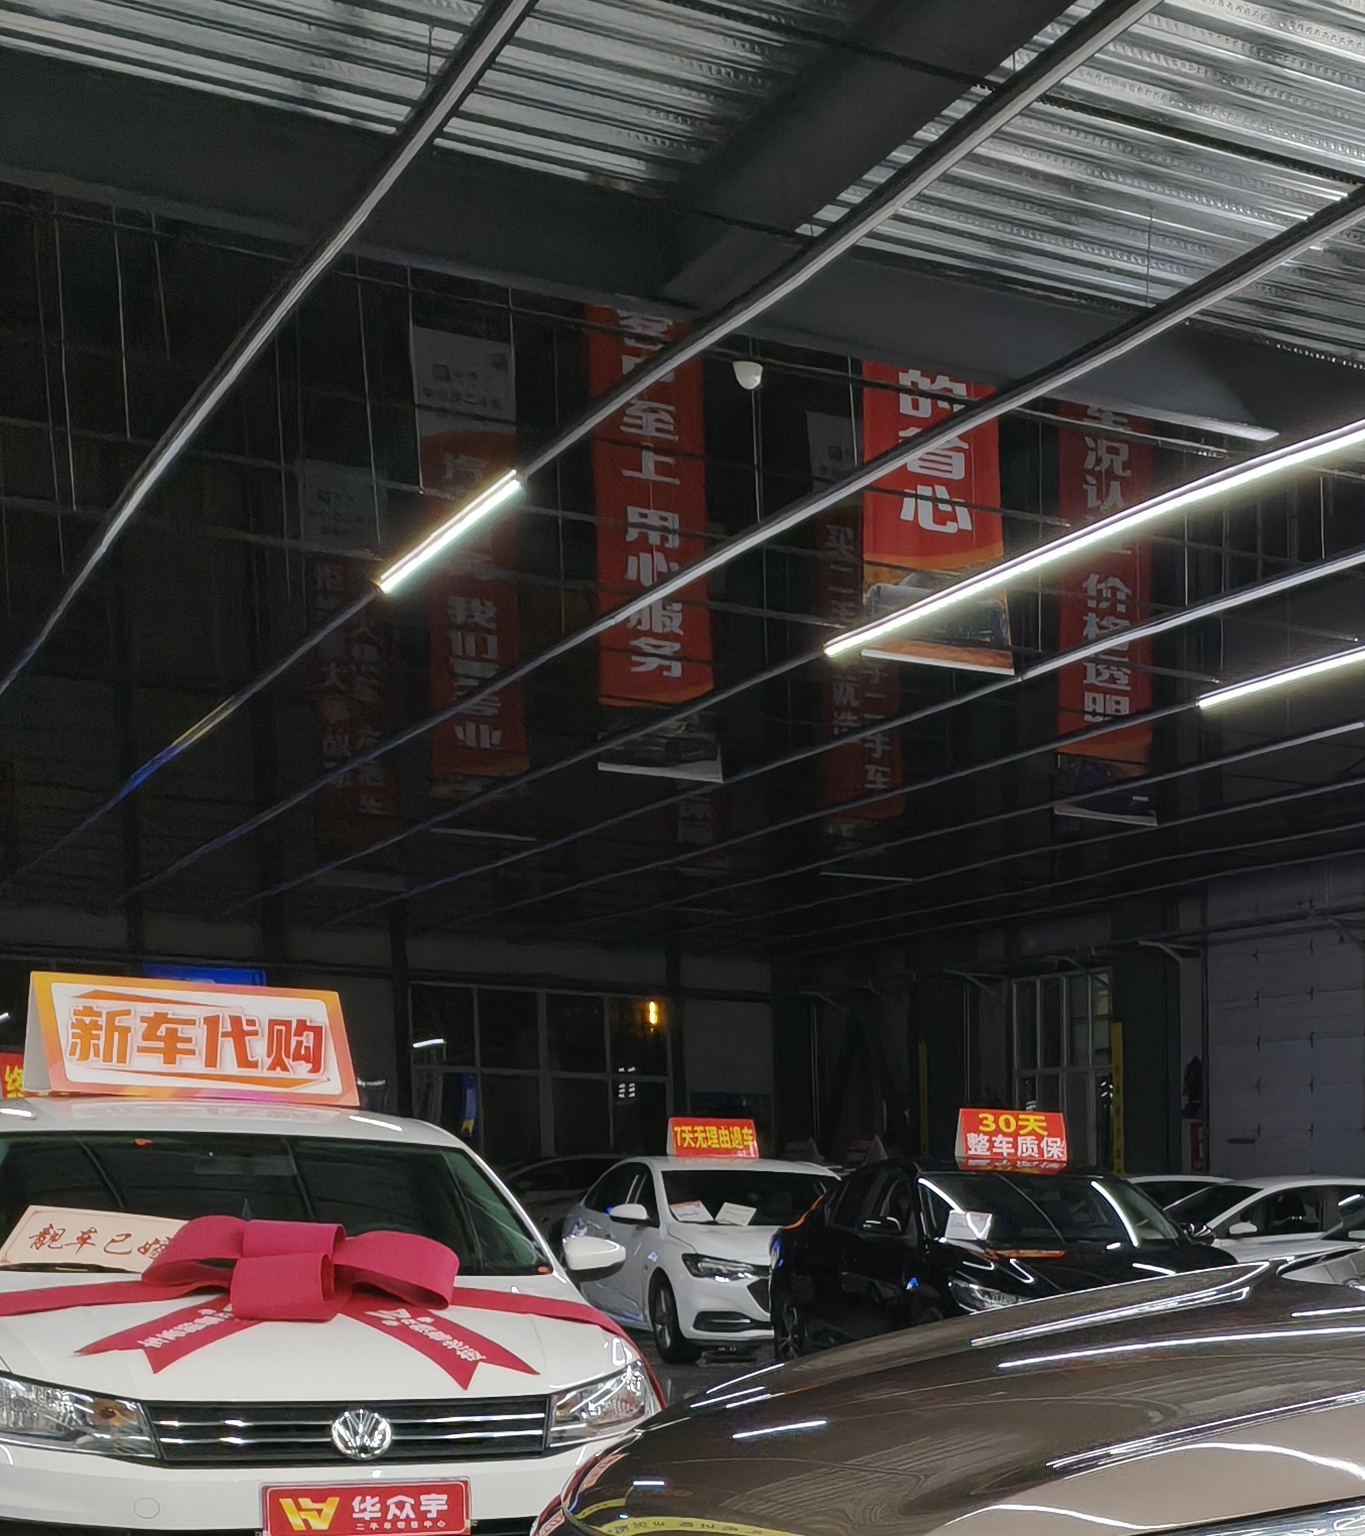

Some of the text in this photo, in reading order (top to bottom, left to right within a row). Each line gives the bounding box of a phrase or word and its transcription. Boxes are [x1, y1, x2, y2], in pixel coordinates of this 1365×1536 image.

[69, 1005, 324, 1075] 新车代购
[978, 1113, 1049, 1136] 30天
[674, 1126, 755, 1151] 7天无理由退车
[966, 1133, 1064, 1159] 整车质保
[352, 1493, 449, 1521] 华众宇
